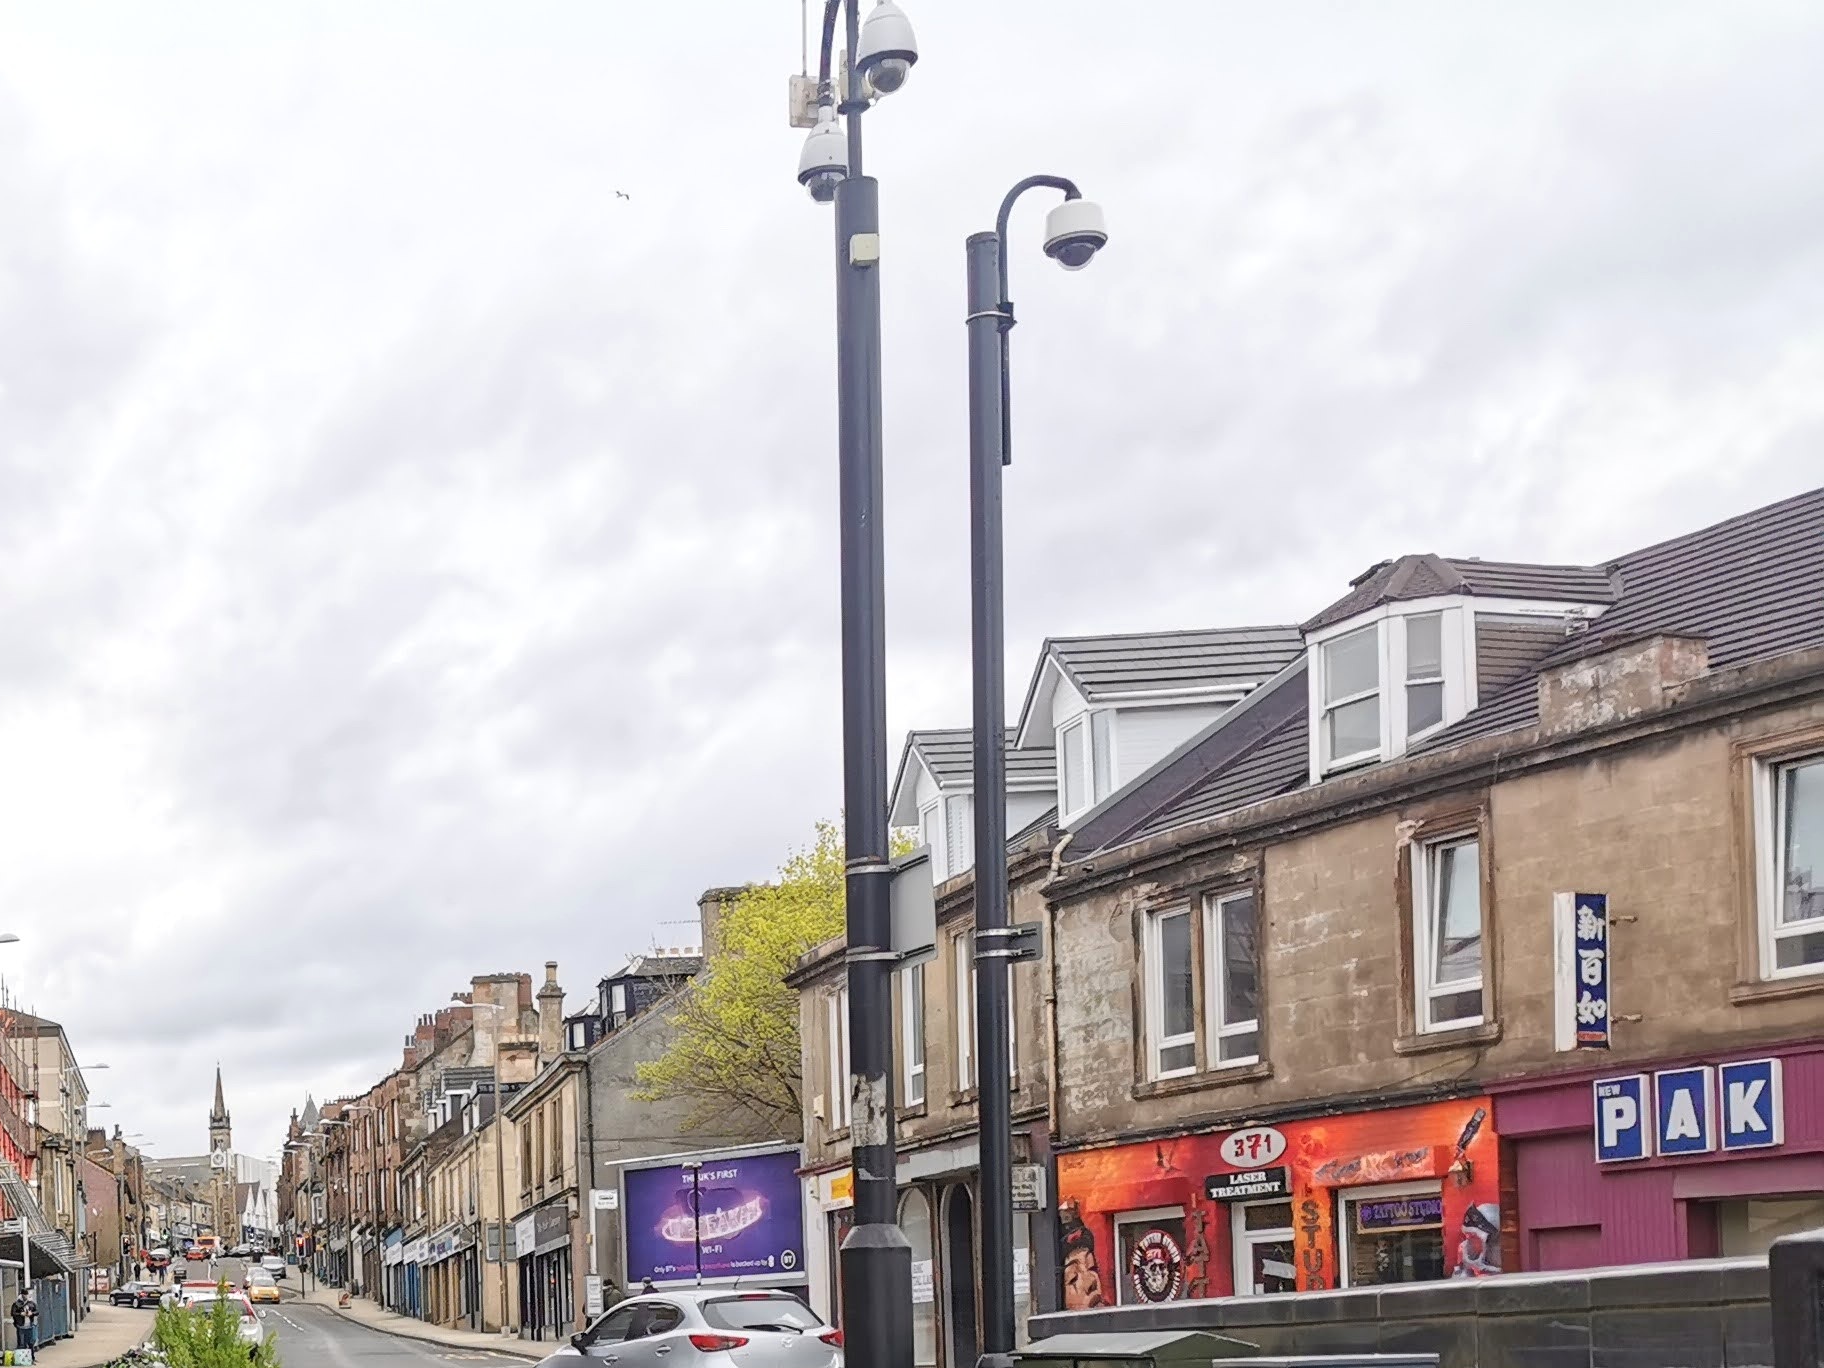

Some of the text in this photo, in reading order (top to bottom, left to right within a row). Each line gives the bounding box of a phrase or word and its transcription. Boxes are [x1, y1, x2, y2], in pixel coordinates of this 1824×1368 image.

[1598, 1085, 1621, 1097] NEW
[1601, 1079, 1768, 1148] PAK
[1234, 1134, 1272, 1160] 371
[717, 1168, 738, 1180] FIRST
[1229, 1171, 1267, 1185] LASER
[1210, 1182, 1281, 1199] TREATMENT
